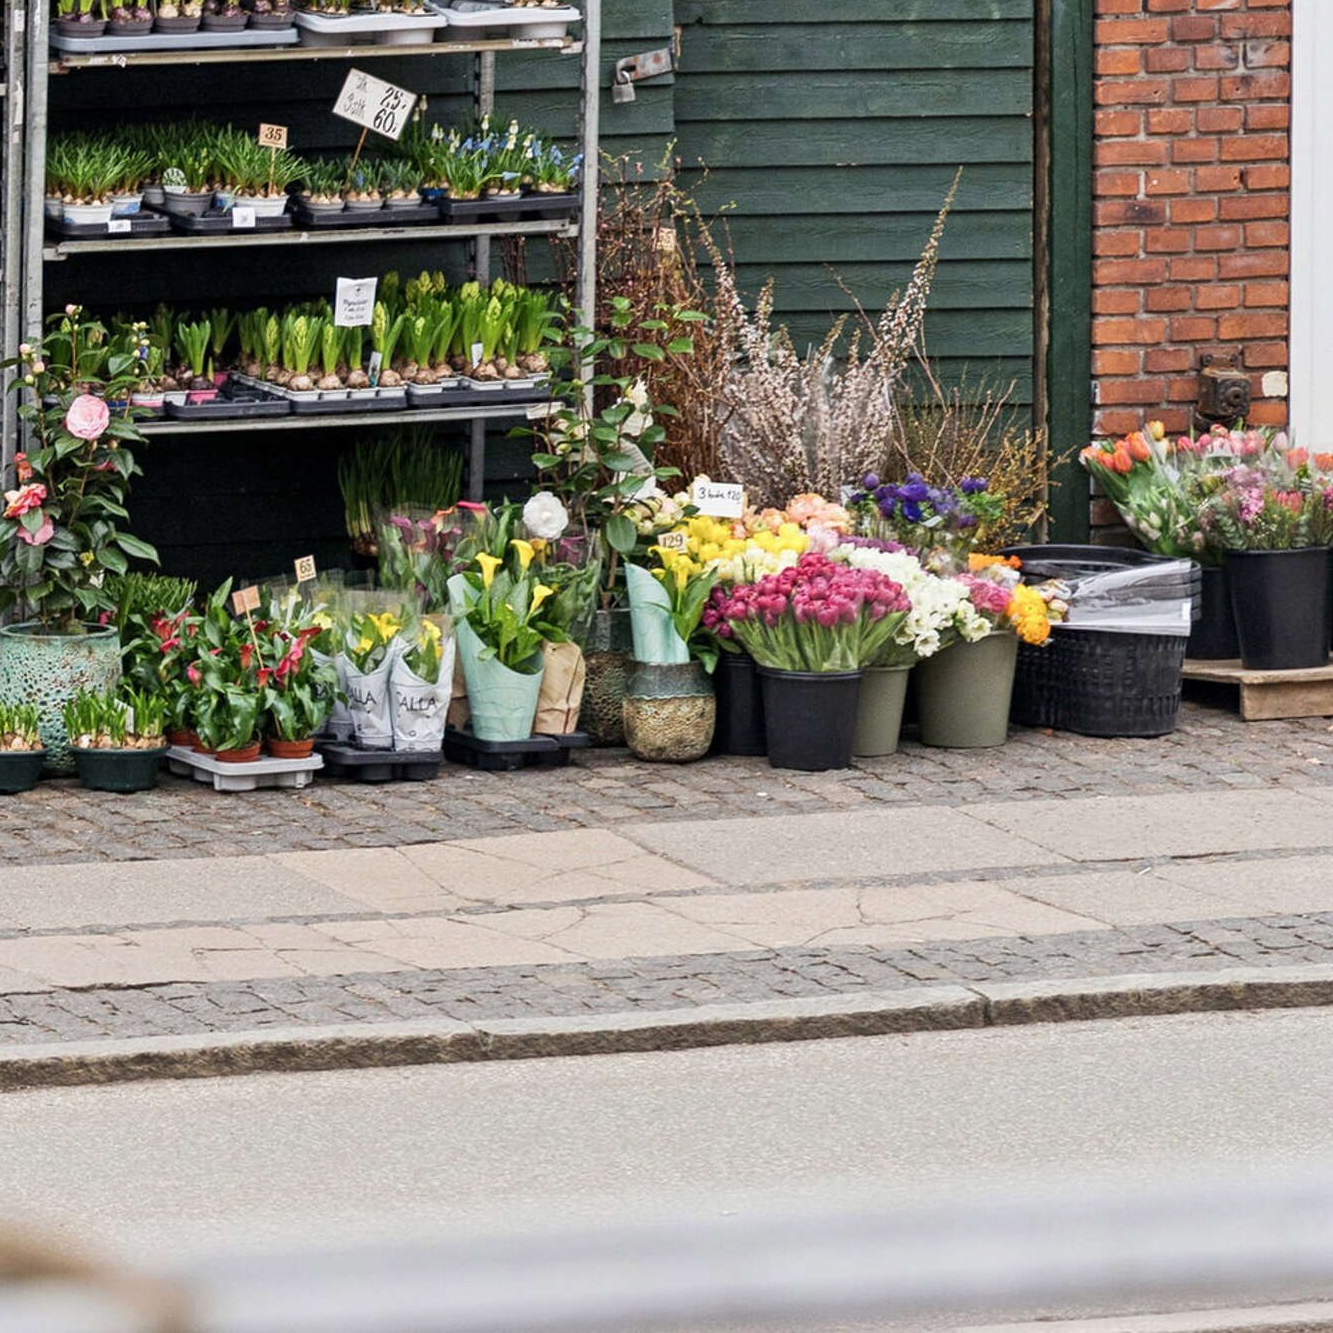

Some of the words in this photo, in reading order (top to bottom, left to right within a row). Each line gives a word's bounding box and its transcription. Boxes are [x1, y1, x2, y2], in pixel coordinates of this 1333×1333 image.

[265, 127, 283, 141] 35
[663, 534, 683, 548] 129
[299, 558, 311, 574] 65
